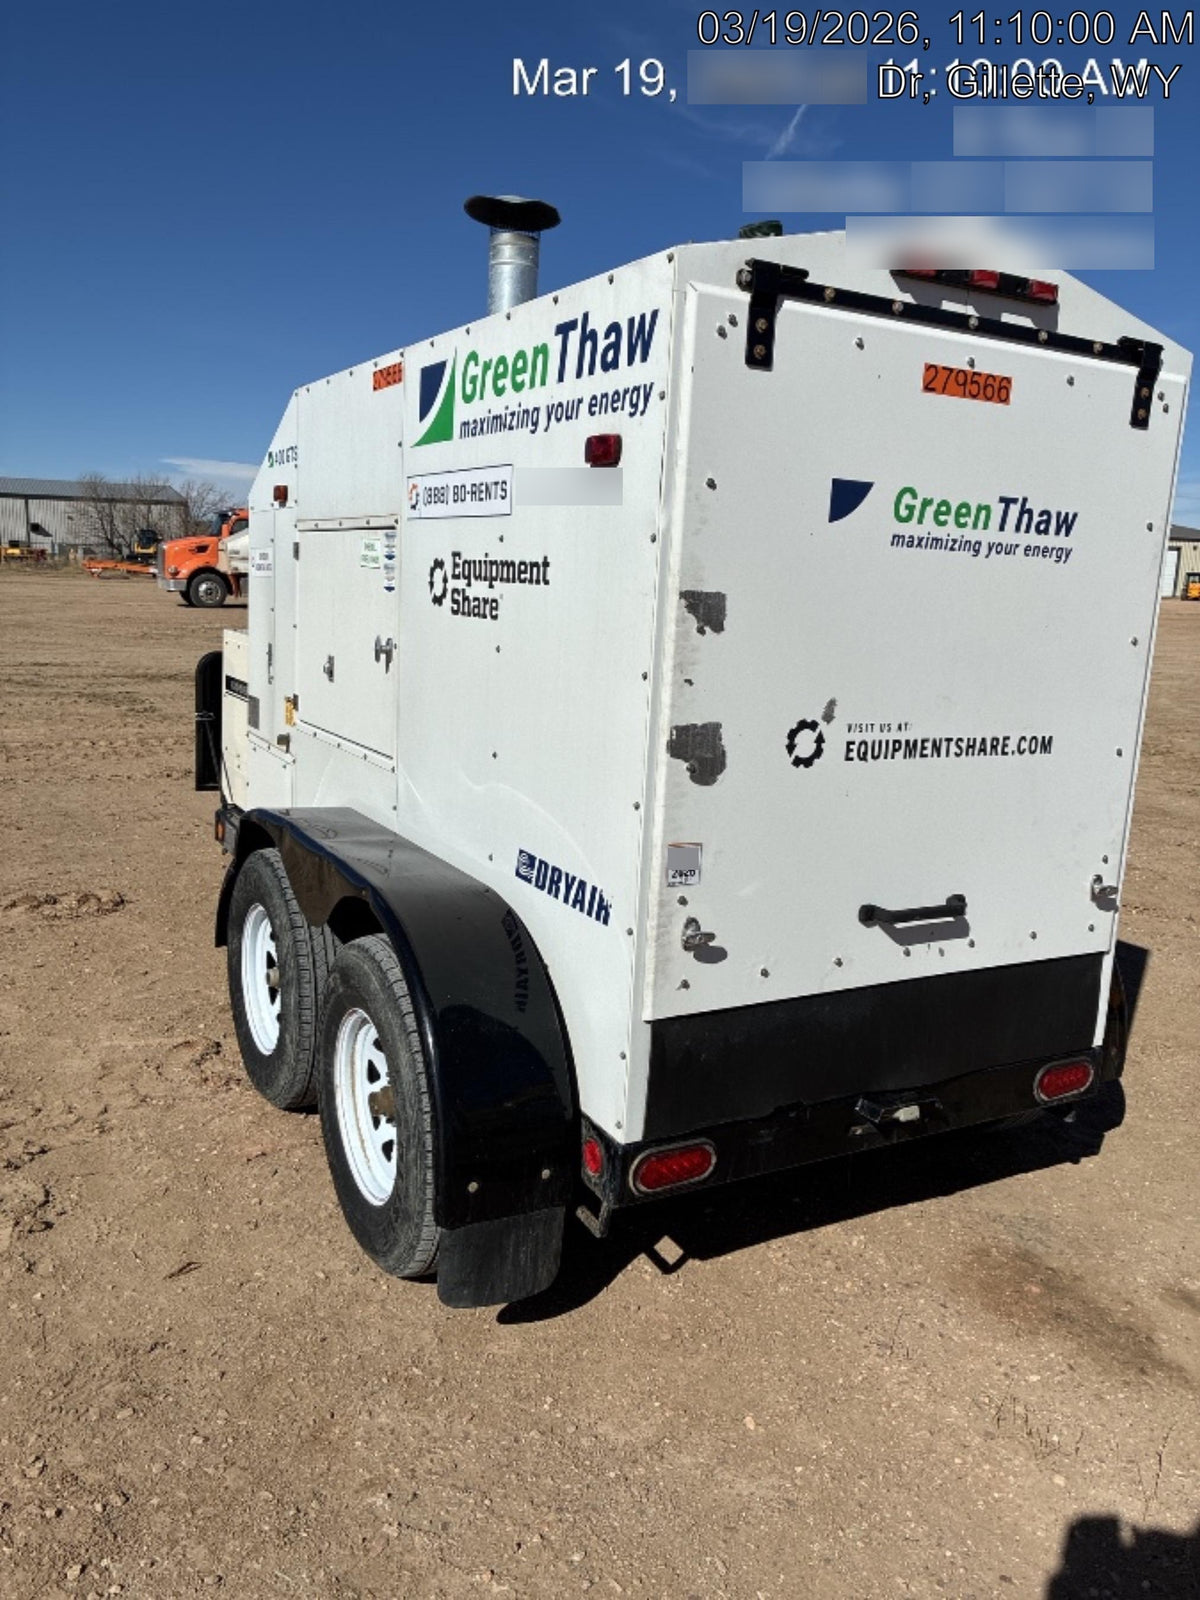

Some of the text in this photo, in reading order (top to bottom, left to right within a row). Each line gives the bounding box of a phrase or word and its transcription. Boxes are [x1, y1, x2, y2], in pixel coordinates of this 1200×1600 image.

[923, 364, 1011, 402] 279566
[459, 381, 654, 439] maximizing your energy
[890, 532, 1073, 563] maximizing your energy
[451, 551, 550, 589] Equipment
[451, 588, 499, 621] Share
[847, 723, 875, 733] VISIT
[879, 723, 892, 733] US
[844, 735, 1053, 763] EQUIPMENTSHARE.COM
[534, 858, 611, 926] DRYAIR
